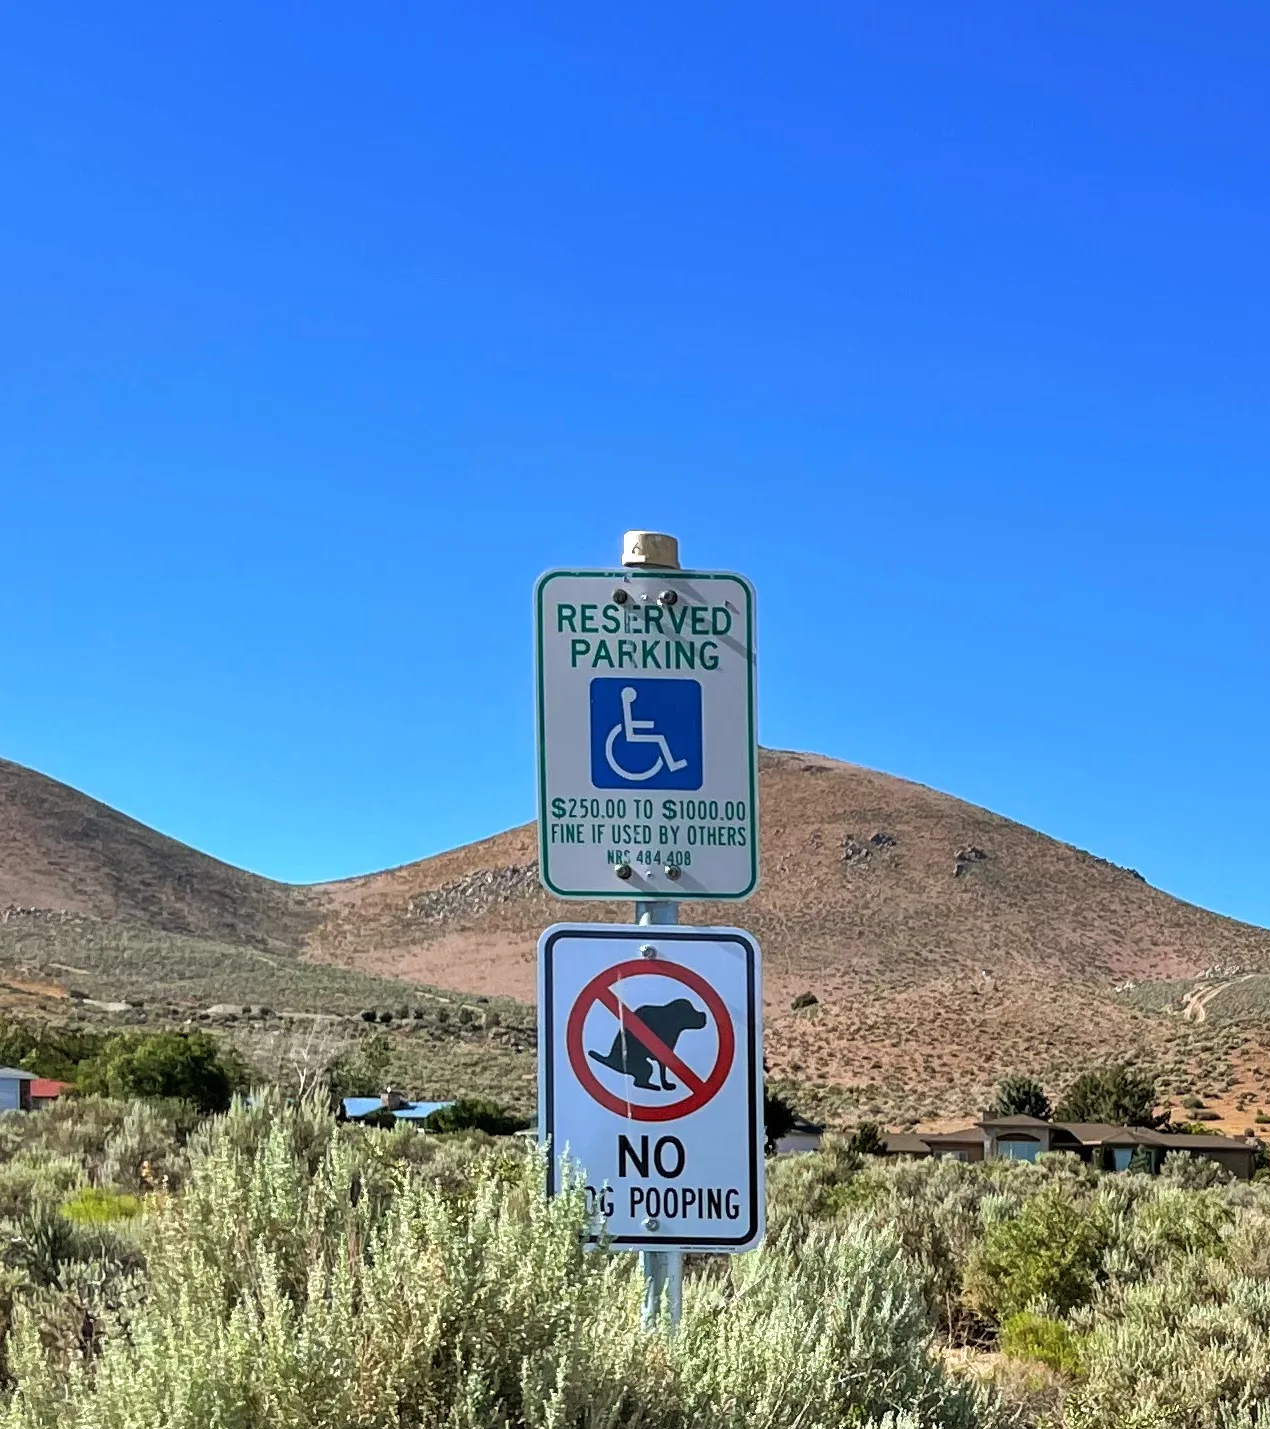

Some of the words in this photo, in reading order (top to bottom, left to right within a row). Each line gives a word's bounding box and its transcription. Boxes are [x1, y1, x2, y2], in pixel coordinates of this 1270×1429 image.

[556, 603, 733, 636] RESERVED
[570, 638, 720, 671] PARKING
[551, 797, 626, 821] $250.00
[634, 798, 653, 820] TO
[662, 798, 746, 822] $1000.00
[551, 823, 585, 844] FINE
[592, 824, 606, 844] IF
[611, 824, 652, 845] USED
[659, 825, 680, 846] BY
[687, 825, 747, 847] OTHERS
[606, 850, 631, 866] NRS
[618, 1134, 686, 1179] NO
[577, 1185, 615, 1218] OG
[629, 1186, 740, 1220] POOPING
